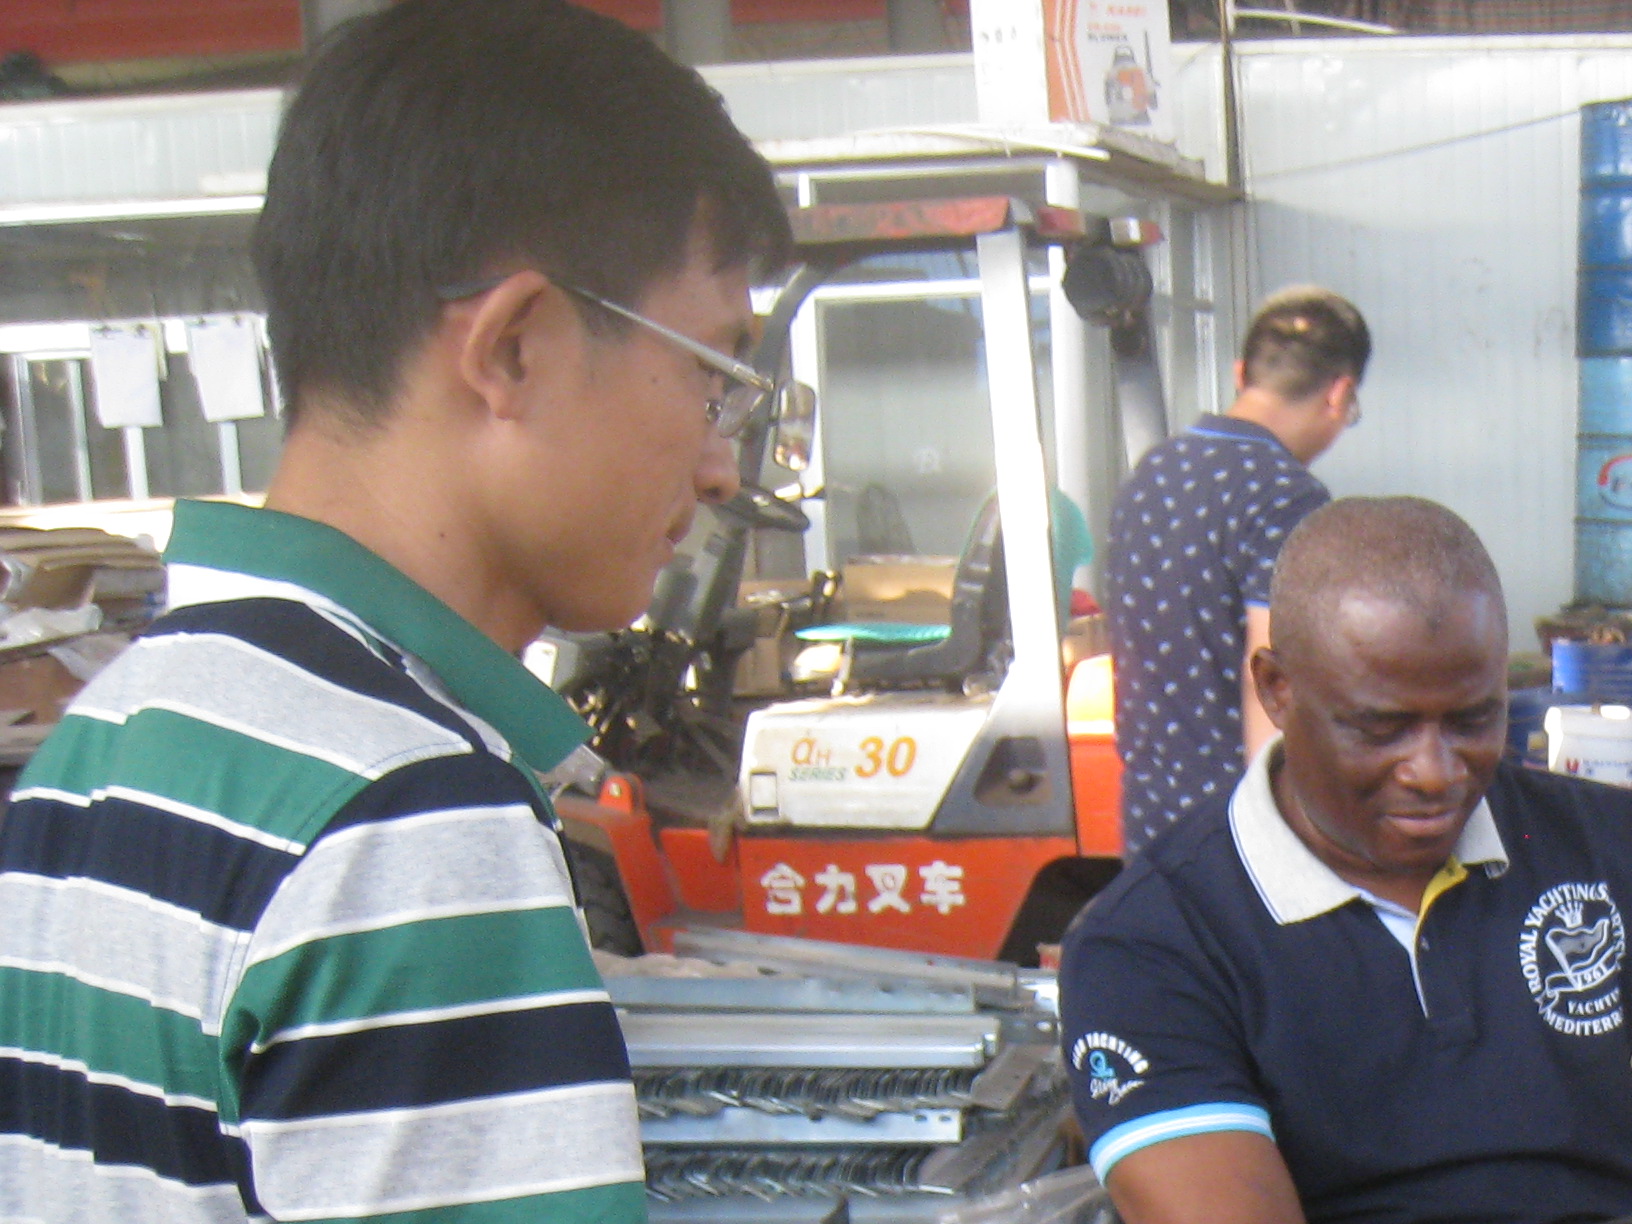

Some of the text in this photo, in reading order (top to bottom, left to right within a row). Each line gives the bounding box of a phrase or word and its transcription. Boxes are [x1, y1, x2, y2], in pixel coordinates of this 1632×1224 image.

[788, 767, 847, 781] SERIES
[854, 736, 917, 778] 30
[760, 860, 966, 914] 合力叉车
[1519, 929, 1542, 994] ROYAL
